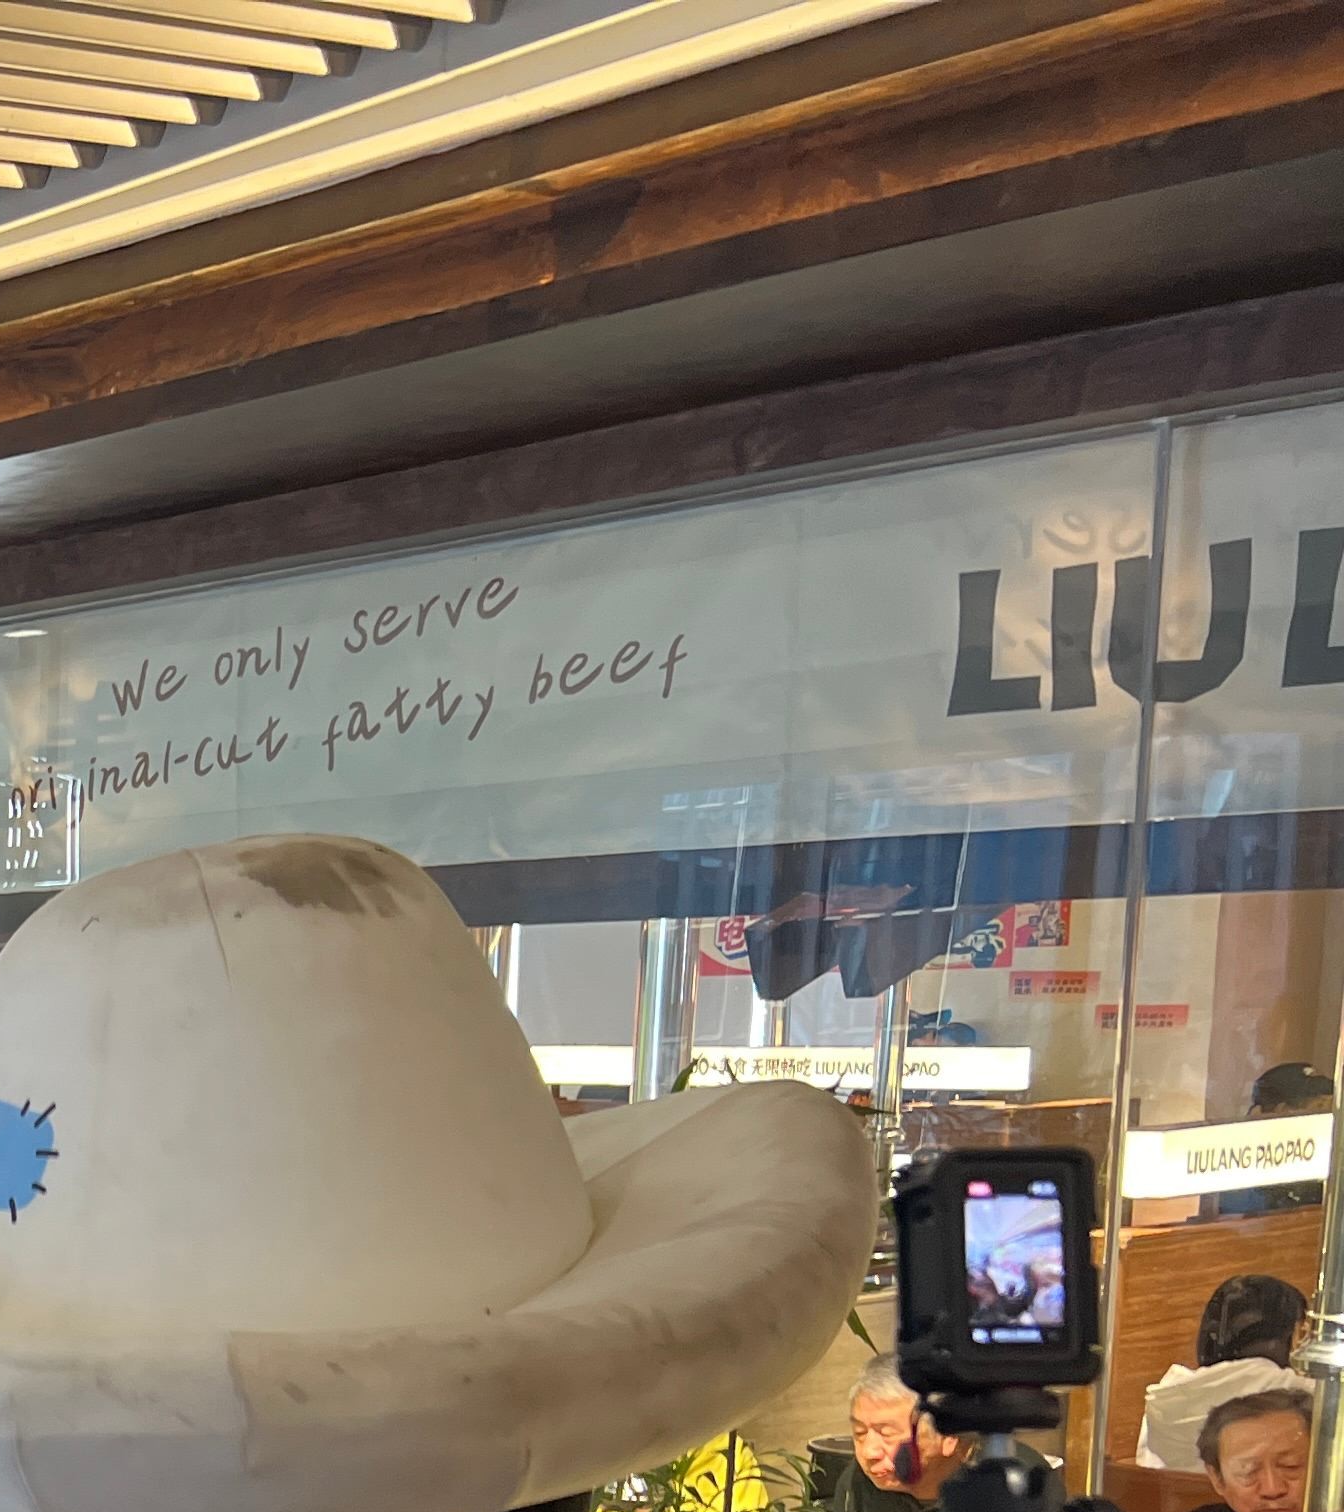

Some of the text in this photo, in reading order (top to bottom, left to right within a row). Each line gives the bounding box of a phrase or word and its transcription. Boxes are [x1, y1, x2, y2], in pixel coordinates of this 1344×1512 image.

[111, 575, 520, 719] We only serve
[10, 633, 688, 830] oriinal-cut fatty beef
[1187, 1138, 1316, 1175] LIULANG PAOPAO
